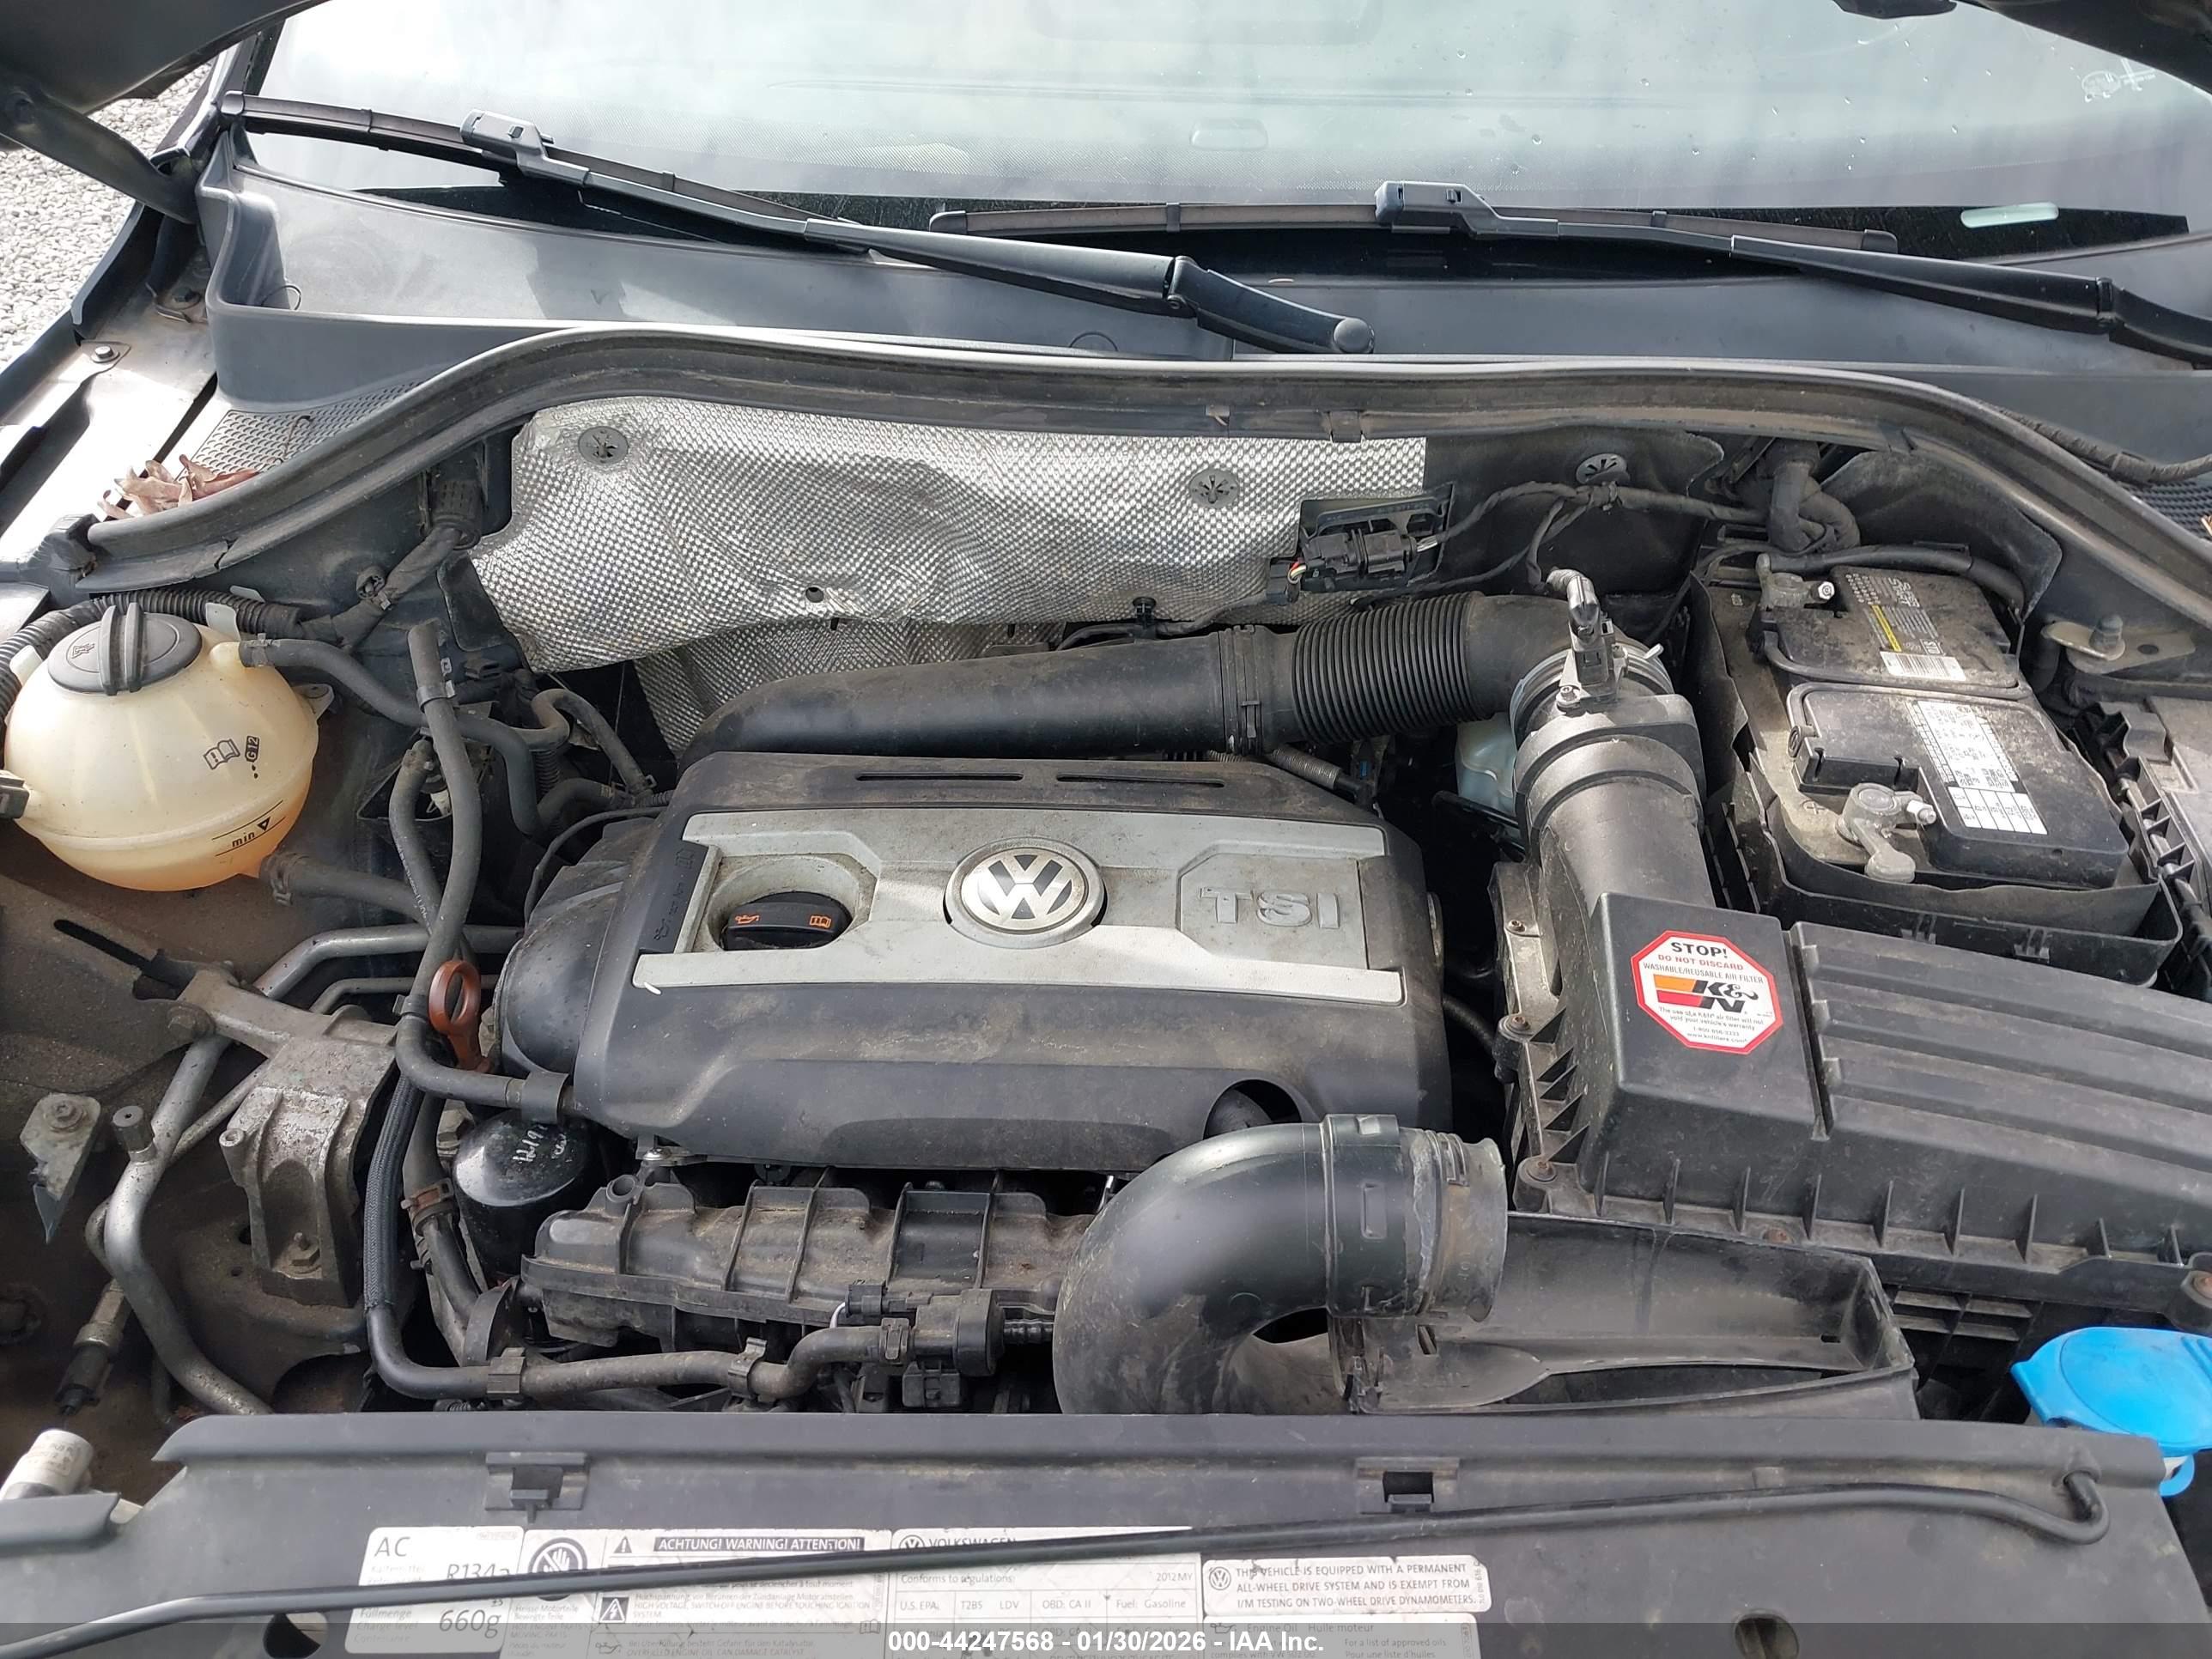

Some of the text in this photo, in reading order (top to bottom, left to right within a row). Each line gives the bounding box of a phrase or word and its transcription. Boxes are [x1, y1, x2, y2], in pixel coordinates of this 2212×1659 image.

[246, 737, 258, 760] G12
[232, 830, 255, 848] min
[1200, 887, 1342, 929] TSI
[1671, 942, 1728, 958] STOP!
[1699, 959, 1744, 970] DISCARD
[1739, 975, 1764, 984] FILTER
[374, 1535, 410, 1557] AC
[659, 1538, 860, 1551] ACHTUNG! WARNING! ATTENTION!
[1237, 1563, 1467, 1579] THIS VEHICLE IS EQUIPPED WITH A PERMANENT
[901, 1573, 945, 1584] Conforms
[949, 1573, 957, 1583] to
[1237, 1578, 1470, 1593] ALL-WHEEL DRIVE SYSTEM AND IS EXEMPT FROM
[999, 1600, 1019, 1610] LDV
[1068, 1600, 1083, 1608] CA
[1144, 1598, 1187, 1608] Gasoline
[1237, 1594, 1476, 1608] I/M TESTING ON TWO-WHEEL DRIVE DYNAMOMETERS.
[440, 1609, 502, 1639] 660g
[1308, 1622, 1375, 1633] Huile moteur
[1345, 1638, 1358, 1647] For
[1366, 1638, 1379, 1647] list
[1381, 1638, 1389, 1647] of
[1392, 1638, 1431, 1650] approved
